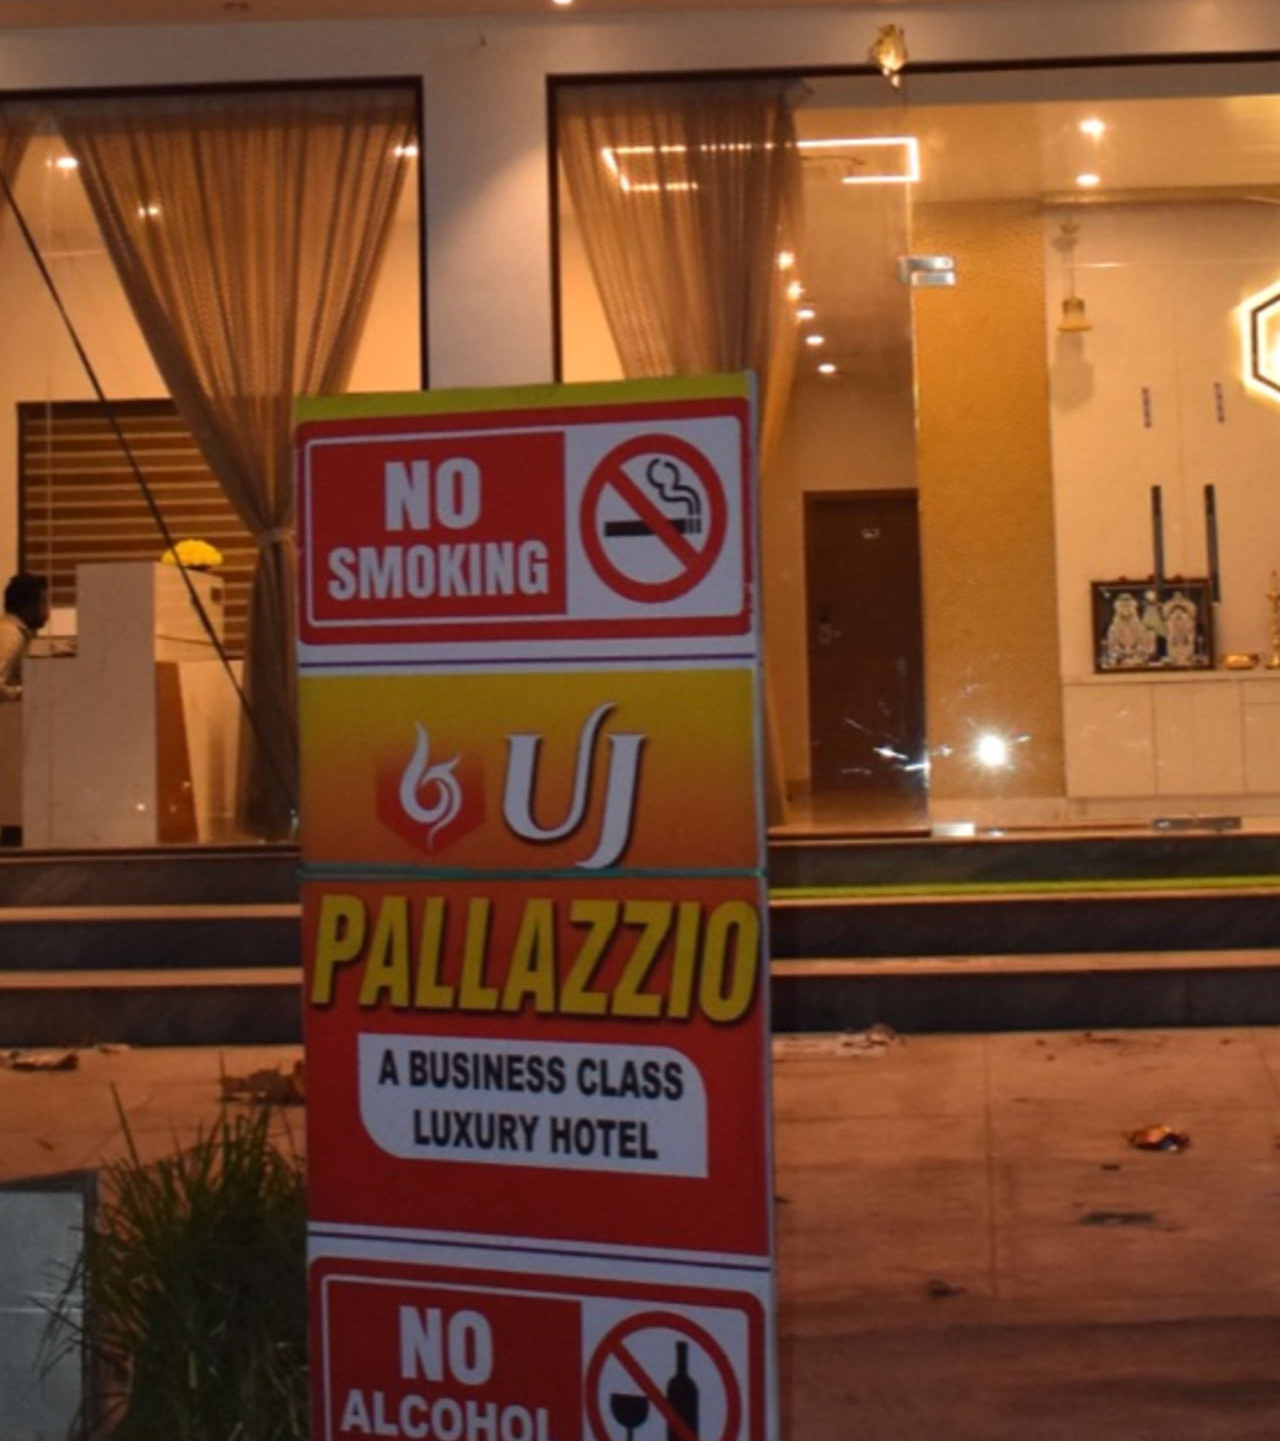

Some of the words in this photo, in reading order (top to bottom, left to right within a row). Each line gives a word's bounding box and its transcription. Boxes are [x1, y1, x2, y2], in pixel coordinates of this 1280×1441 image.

[384, 456, 482, 532] NO
[327, 539, 550, 601] SMOKING
[501, 701, 648, 870] UJ
[310, 893, 761, 1022] PALLAZZIO
[377, 1049, 400, 1087] A
[409, 1050, 567, 1096] BUSINESS
[577, 1058, 684, 1102] CLASS
[413, 1109, 540, 1154] LUXURY
[549, 1116, 659, 1161] HOTEL
[398, 1304, 493, 1387] NO
